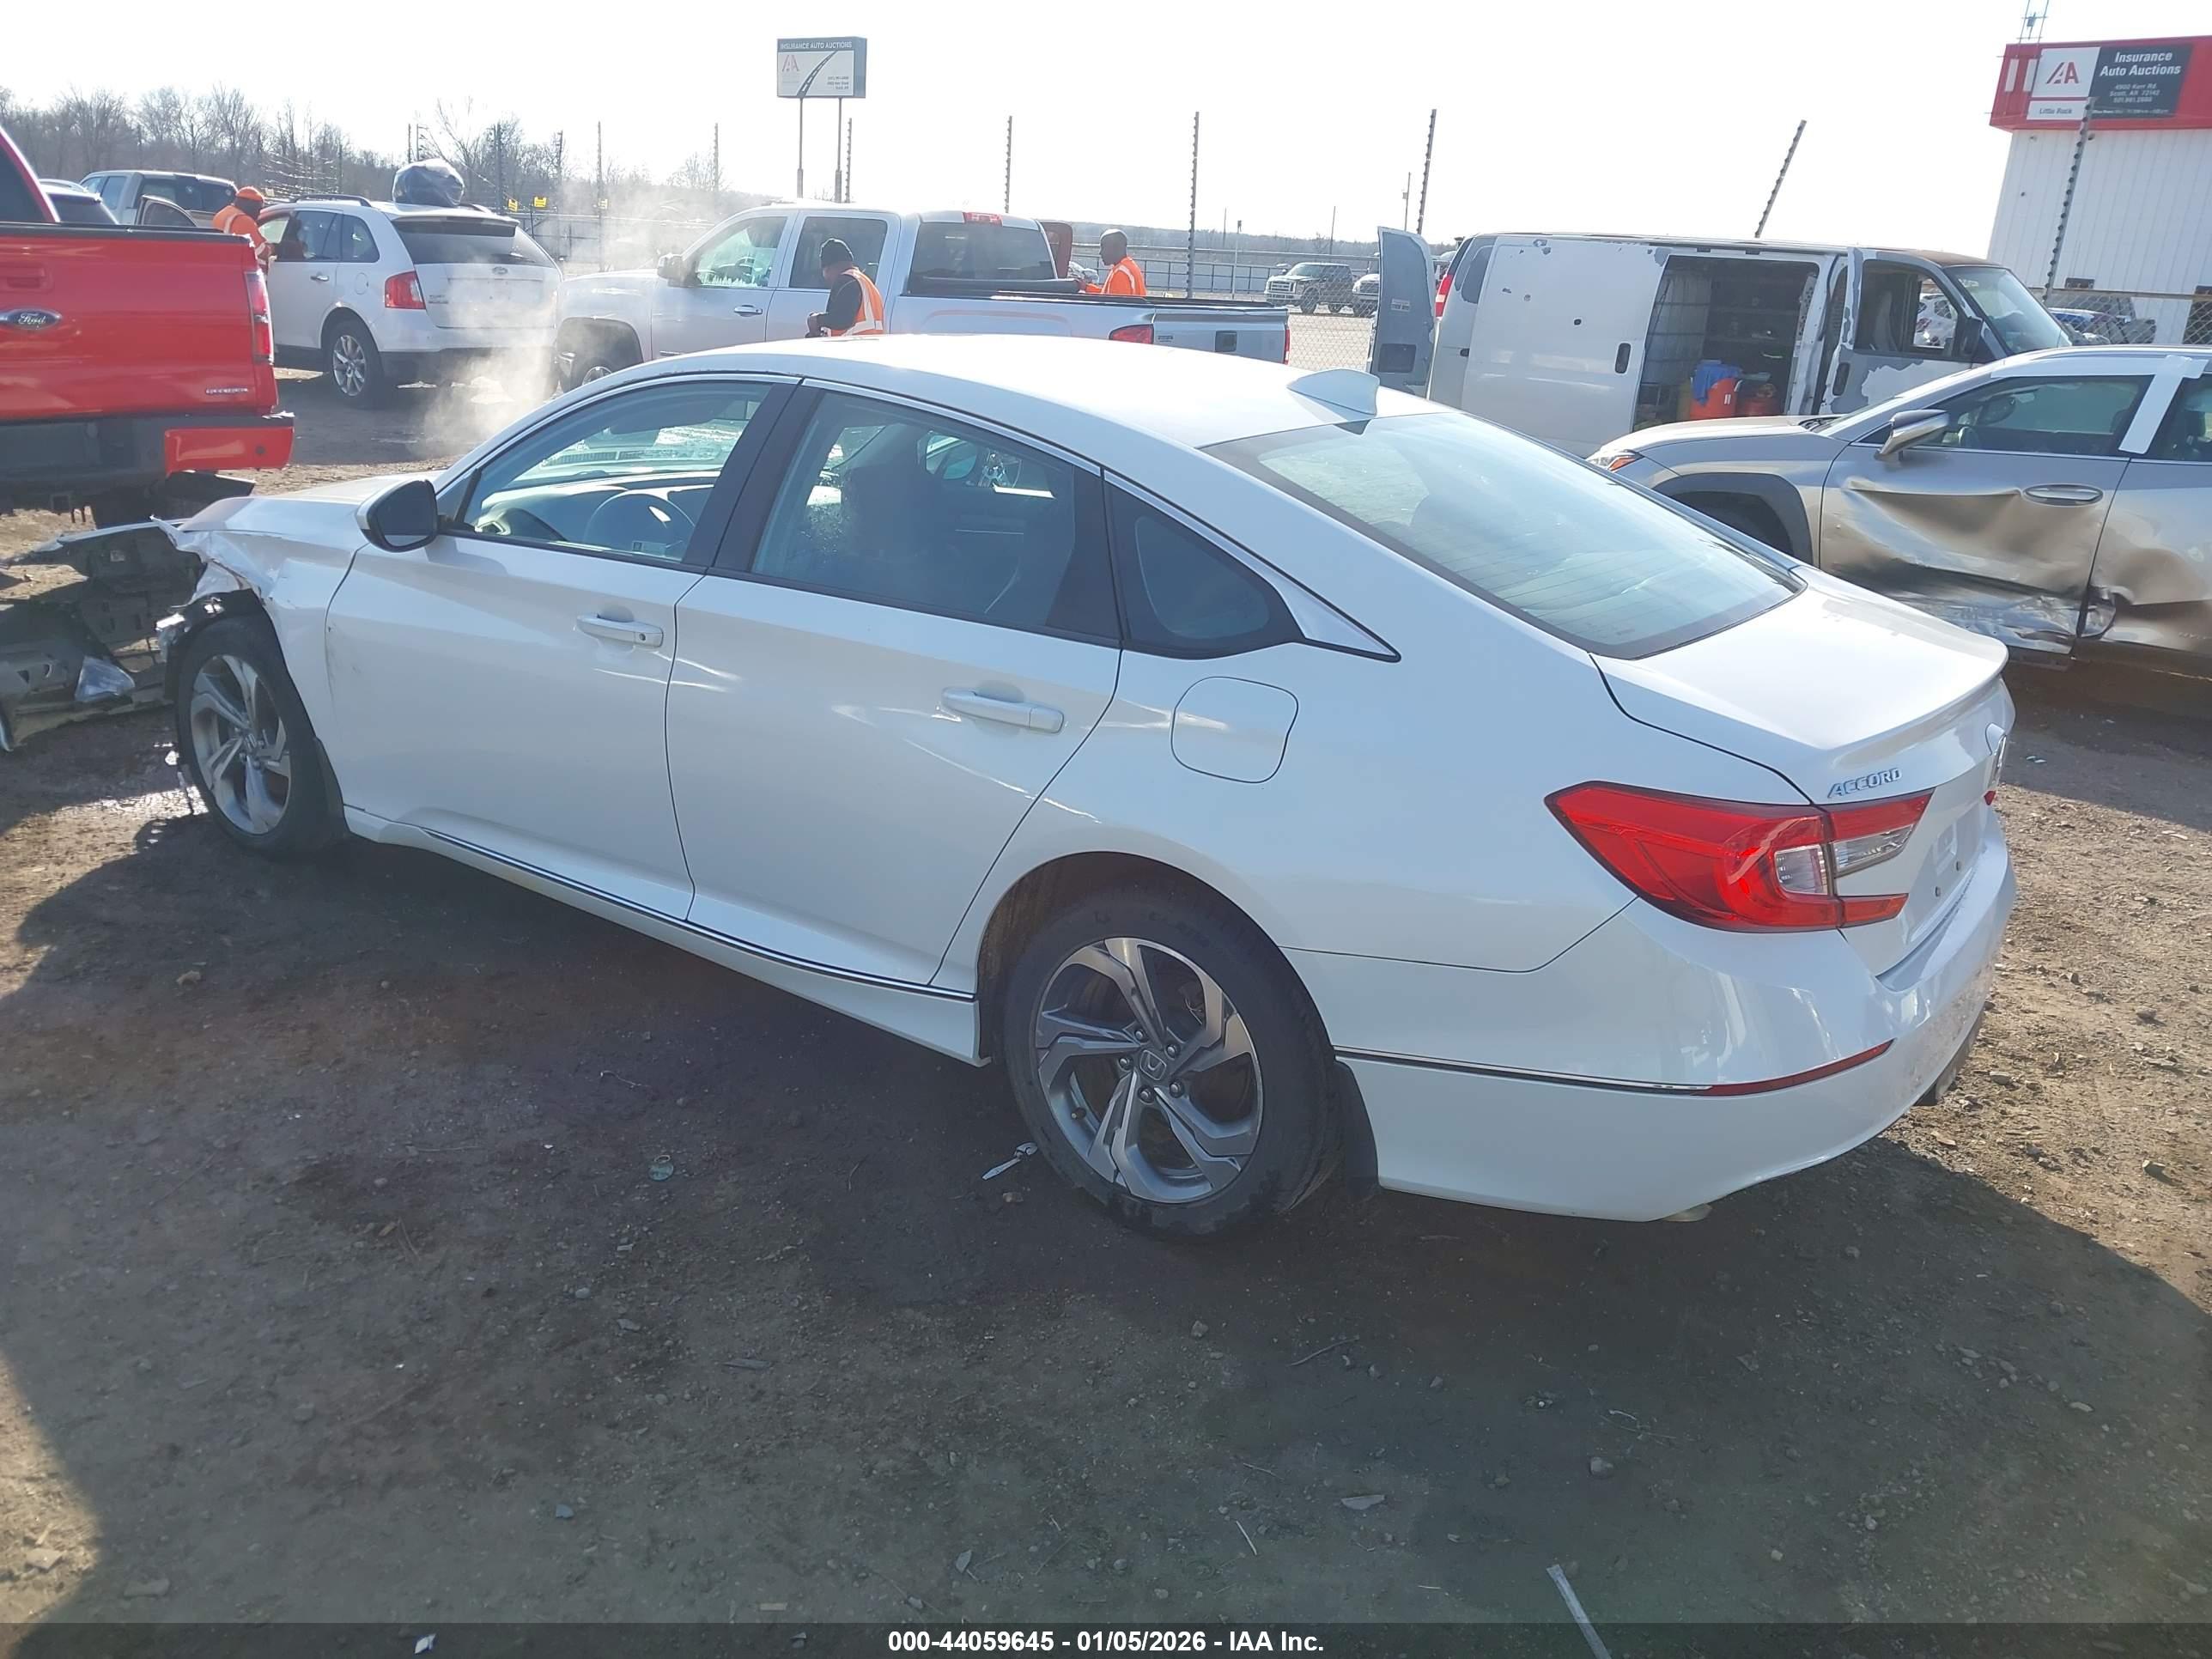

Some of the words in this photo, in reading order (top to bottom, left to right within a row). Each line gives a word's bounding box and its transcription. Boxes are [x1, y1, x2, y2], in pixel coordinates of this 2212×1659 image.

[2115, 52, 2172, 63] Insurance
[2100, 65, 2127, 76] Auto
[2129, 64, 2182, 76] Auctions
[18, 313, 46, 325] Ford
[1827, 768, 1903, 799] ACCORD
